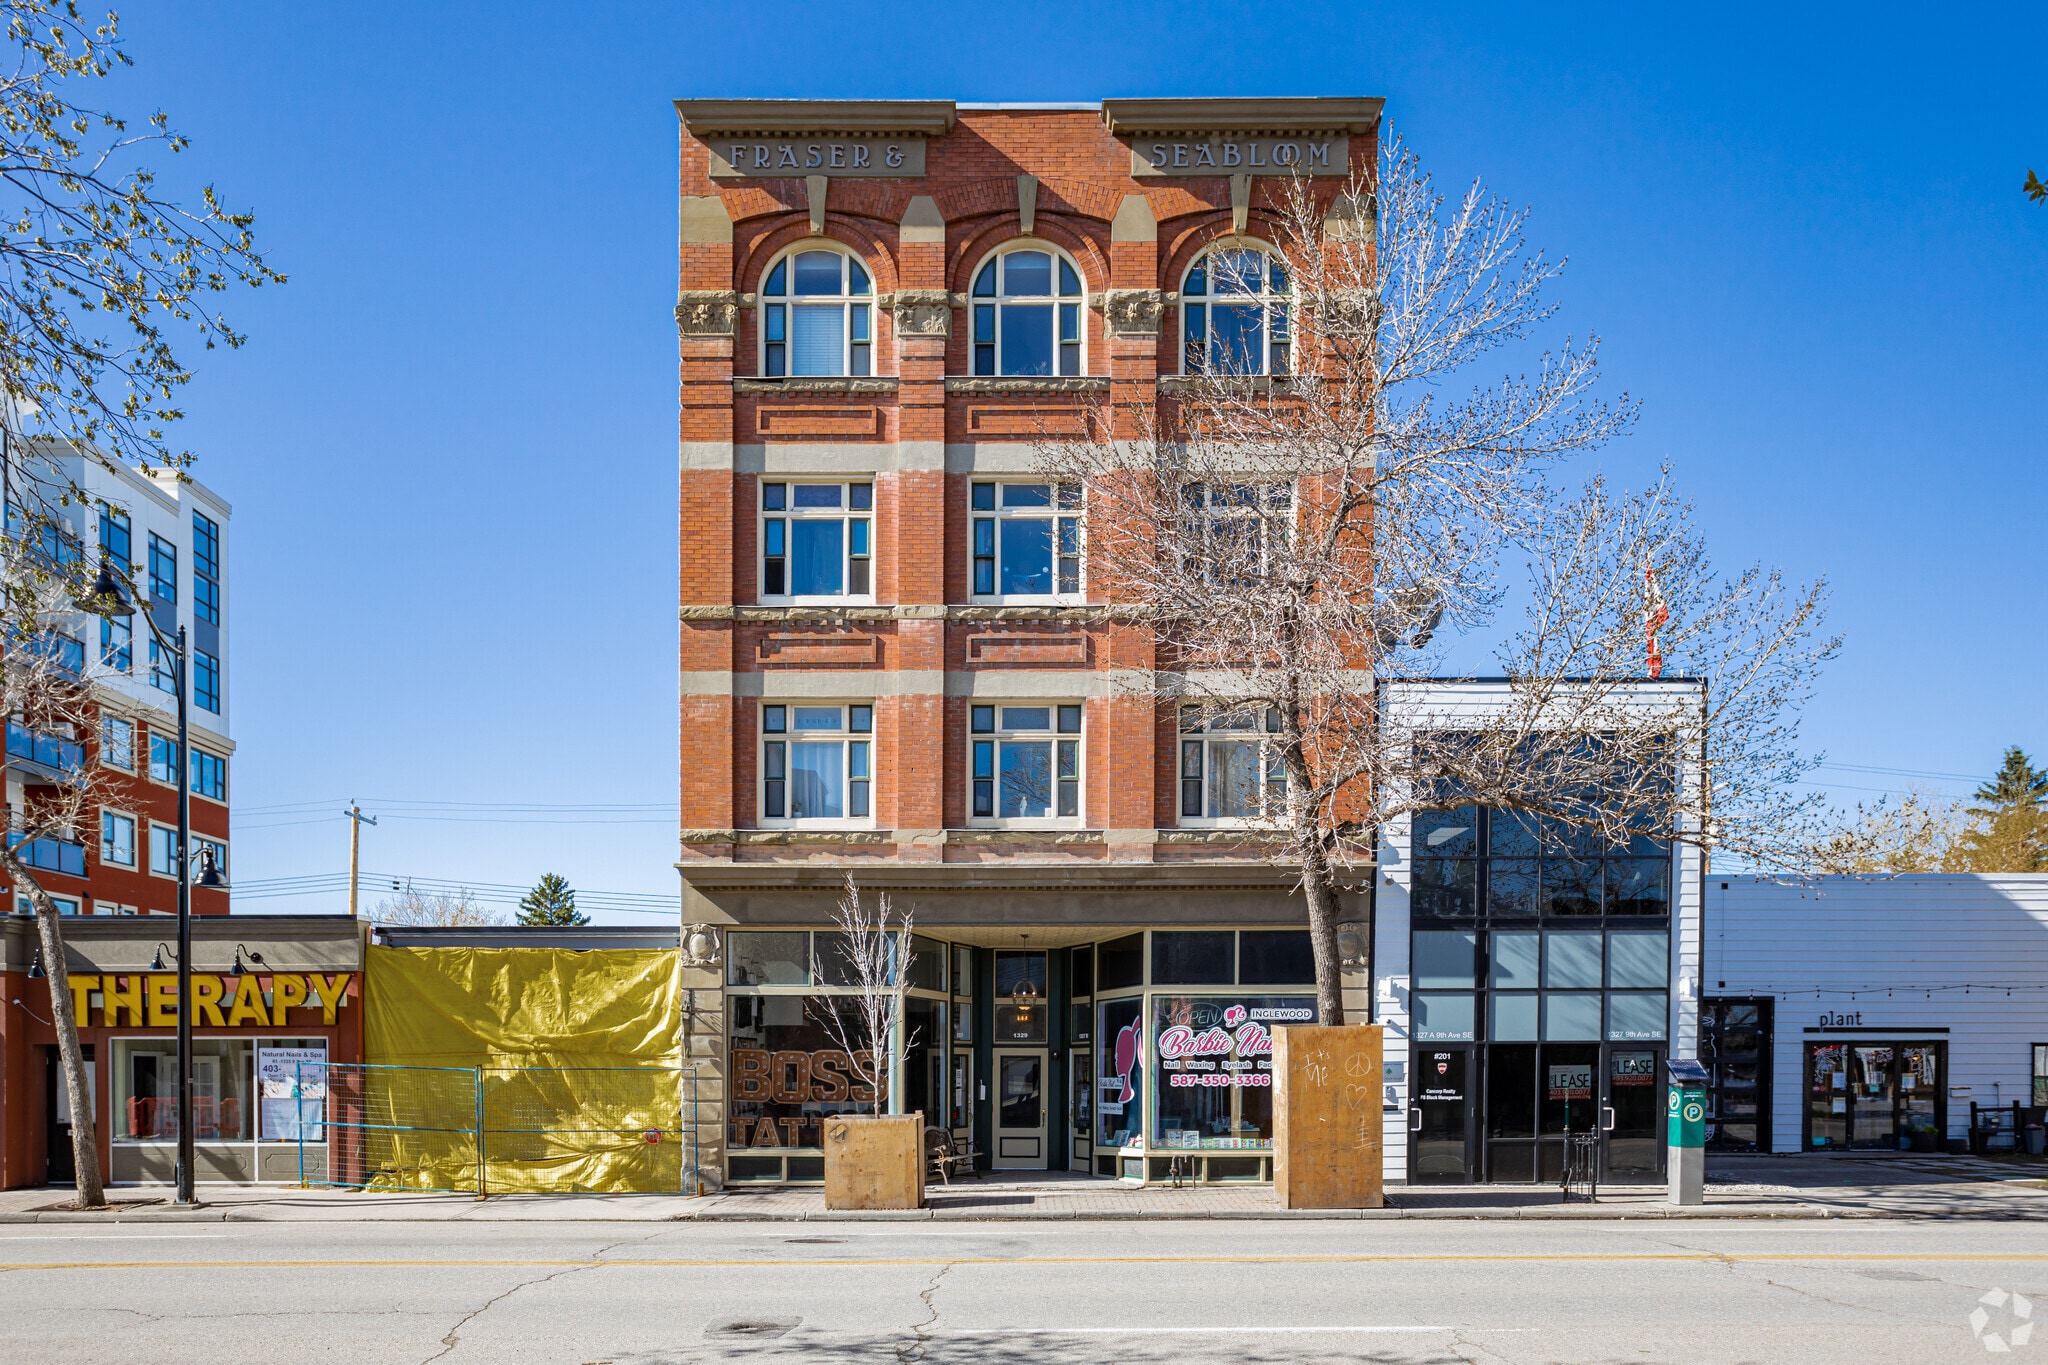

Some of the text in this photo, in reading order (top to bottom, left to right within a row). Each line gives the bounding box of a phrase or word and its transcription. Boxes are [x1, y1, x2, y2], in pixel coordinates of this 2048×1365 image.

[730, 145, 905, 168] FRASER &
[1151, 143, 1329, 167] SEABLOOM
[67, 974, 350, 1027] THERAPY
[1178, 1009, 1219, 1026] OPEN
[1252, 1010, 1311, 1018] INGLEWOOD
[1820, 1011, 1862, 1032] plant
[1160, 1027, 1232, 1058] Barbie
[263, 1064, 281, 1073] 403-
[1187, 1061, 1215, 1070] Waxing
[1222, 1061, 1252, 1070] Eyelash
[1616, 1060, 1653, 1074] LEASE
[732, 1049, 889, 1104] BOSS
[1171, 1075, 1270, 1086] 587-350-3366
[1554, 1073, 1591, 1089] LEASE
